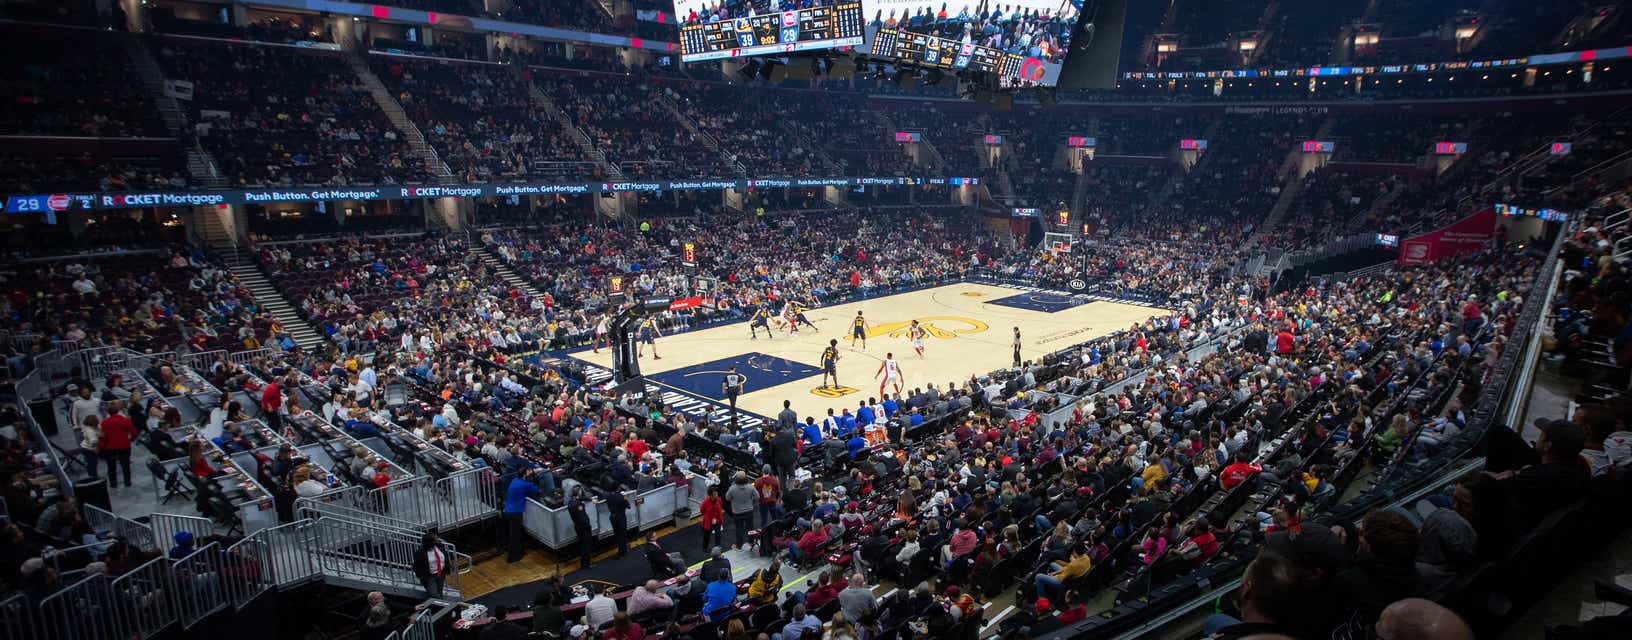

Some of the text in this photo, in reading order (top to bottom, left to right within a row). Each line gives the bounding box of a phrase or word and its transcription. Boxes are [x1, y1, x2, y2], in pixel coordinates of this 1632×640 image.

[741, 34, 753, 47] 39
[760, 35, 776, 45] 9:02
[783, 29, 796, 42] 29
[928, 50, 937, 62] 39
[957, 55, 967, 66] 29
[1276, 106, 1308, 114] LEGENDS
[1309, 106, 1329, 114] CLUB
[401, 187, 481, 198] ROCKET Mortgage
[541, 185, 553, 193] Get
[602, 183, 660, 191] ROCKET Mortgage
[102, 193, 223, 206] ROCKET Mortgage
[246, 192, 271, 201] Push
[273, 191, 310, 200] Button.
[312, 191, 328, 200] Get
[17, 198, 39, 211] 29
[82, 199, 91, 209] 2
